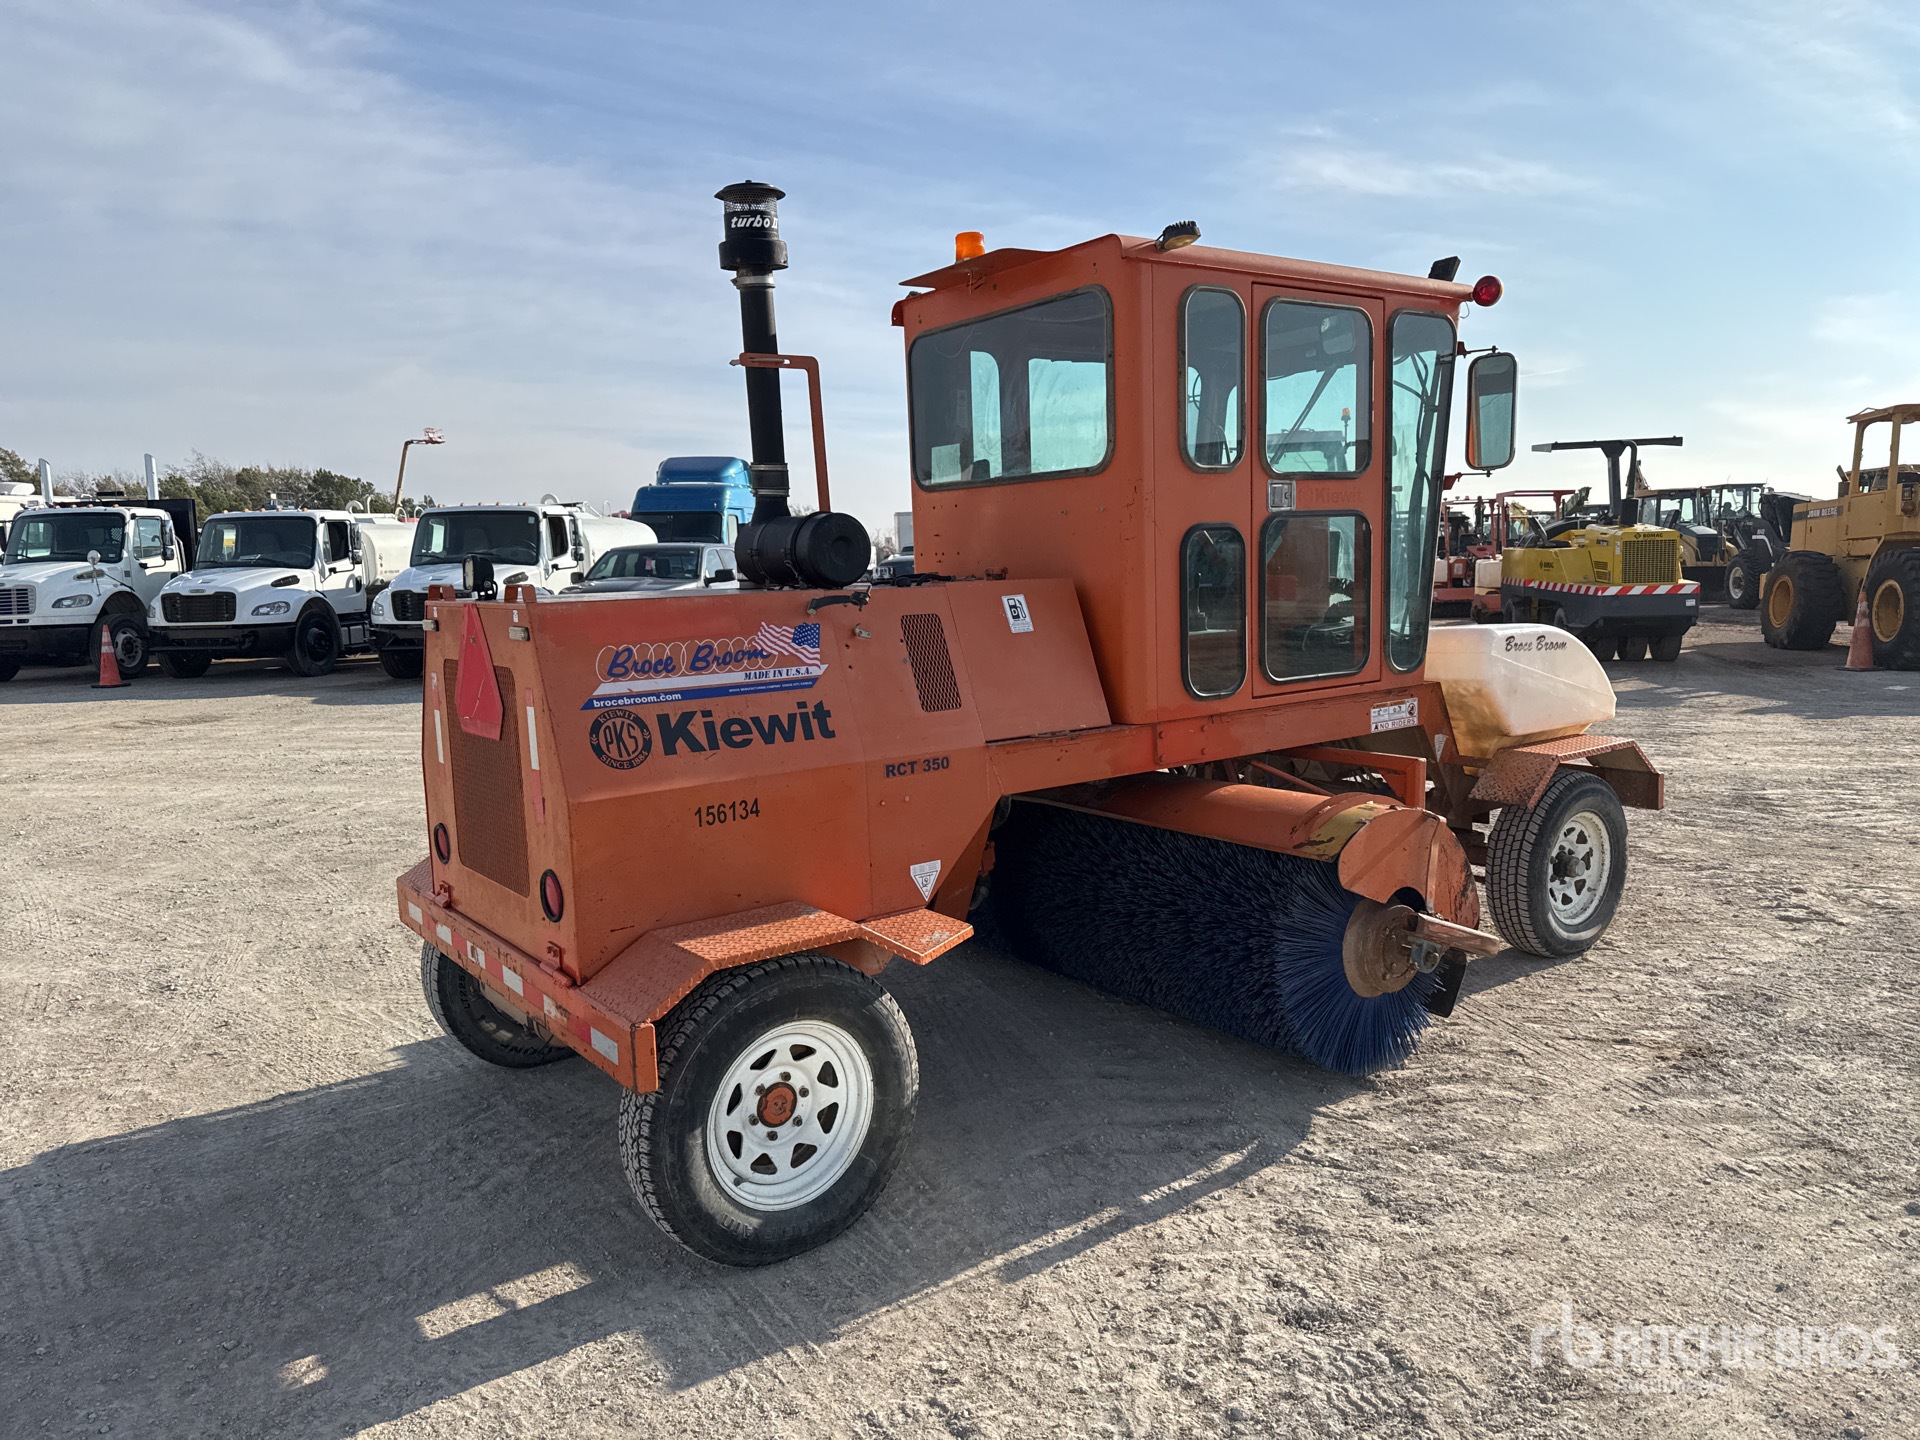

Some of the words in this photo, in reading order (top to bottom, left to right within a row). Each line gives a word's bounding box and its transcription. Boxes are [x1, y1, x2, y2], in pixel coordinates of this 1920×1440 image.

[731, 214, 771, 229] turbo
[1505, 635, 1533, 652] Broce
[1535, 635, 1567, 651] Broom
[607, 647, 677, 678] Broce
[689, 644, 772, 672] Broom
[744, 670, 771, 681] MADE
[773, 669, 783, 678] IN
[786, 666, 813, 677] U.S.A.
[593, 692, 682, 708] brocebroom.com
[598, 710, 637, 723] KIEWIT
[1380, 722, 1390, 730] NO
[1391, 718, 1416, 728] RIDERS
[656, 700, 836, 756] Kiewit
[603, 721, 639, 758] PKS
[600, 754, 631, 769] SINCE
[631, 750, 649, 767] 1884
[885, 760, 918, 778] RCT
[922, 756, 950, 772] 350
[694, 798, 761, 828] 156134
